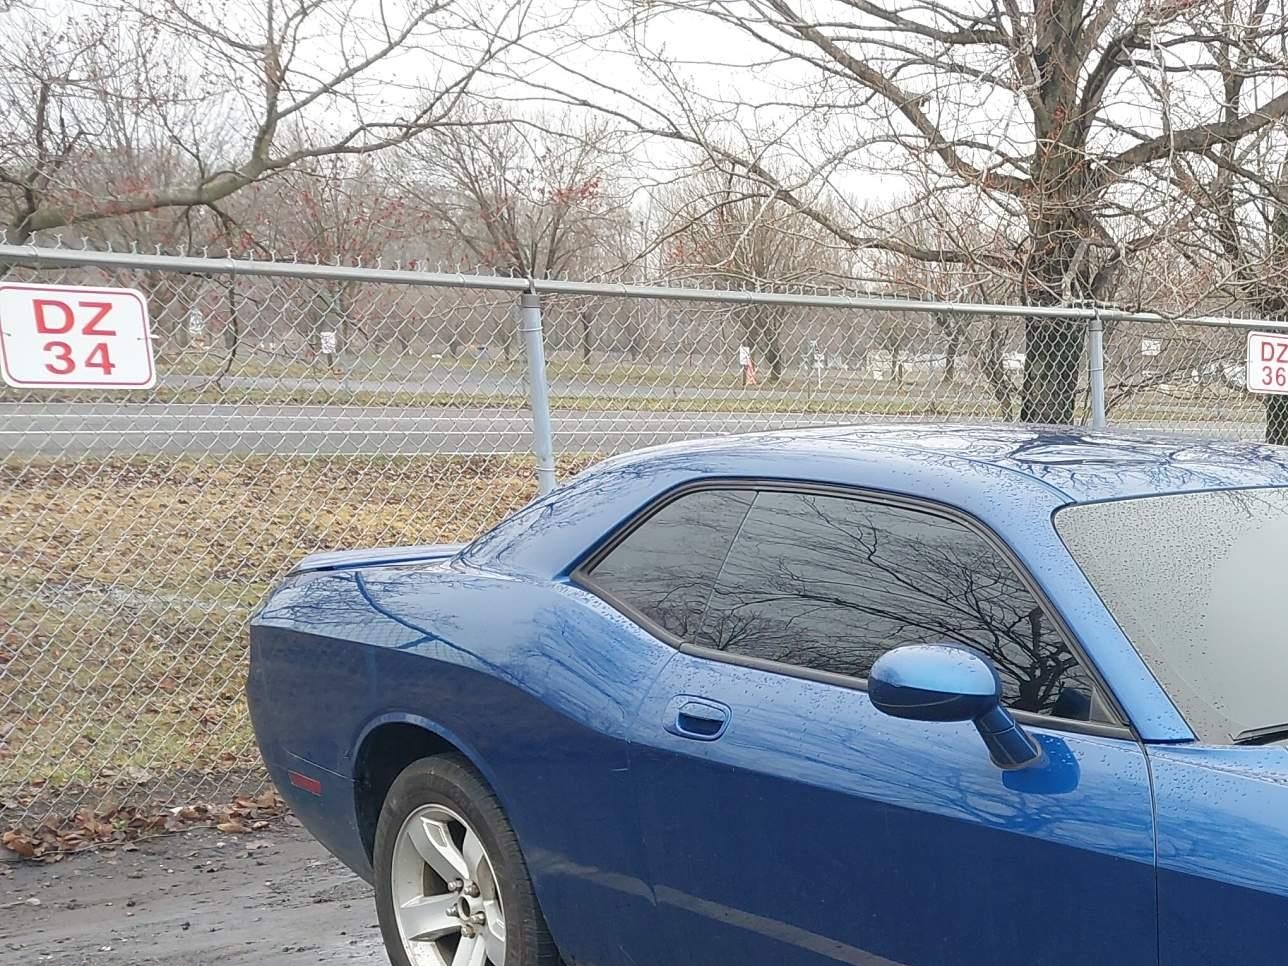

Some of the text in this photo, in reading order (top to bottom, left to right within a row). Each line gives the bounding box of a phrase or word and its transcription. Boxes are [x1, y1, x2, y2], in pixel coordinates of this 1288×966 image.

[32, 298, 117, 337] DZ
[43, 340, 116, 376] 34
[1261, 341, 1288, 364] DZ
[1262, 365, 1287, 387] 36
